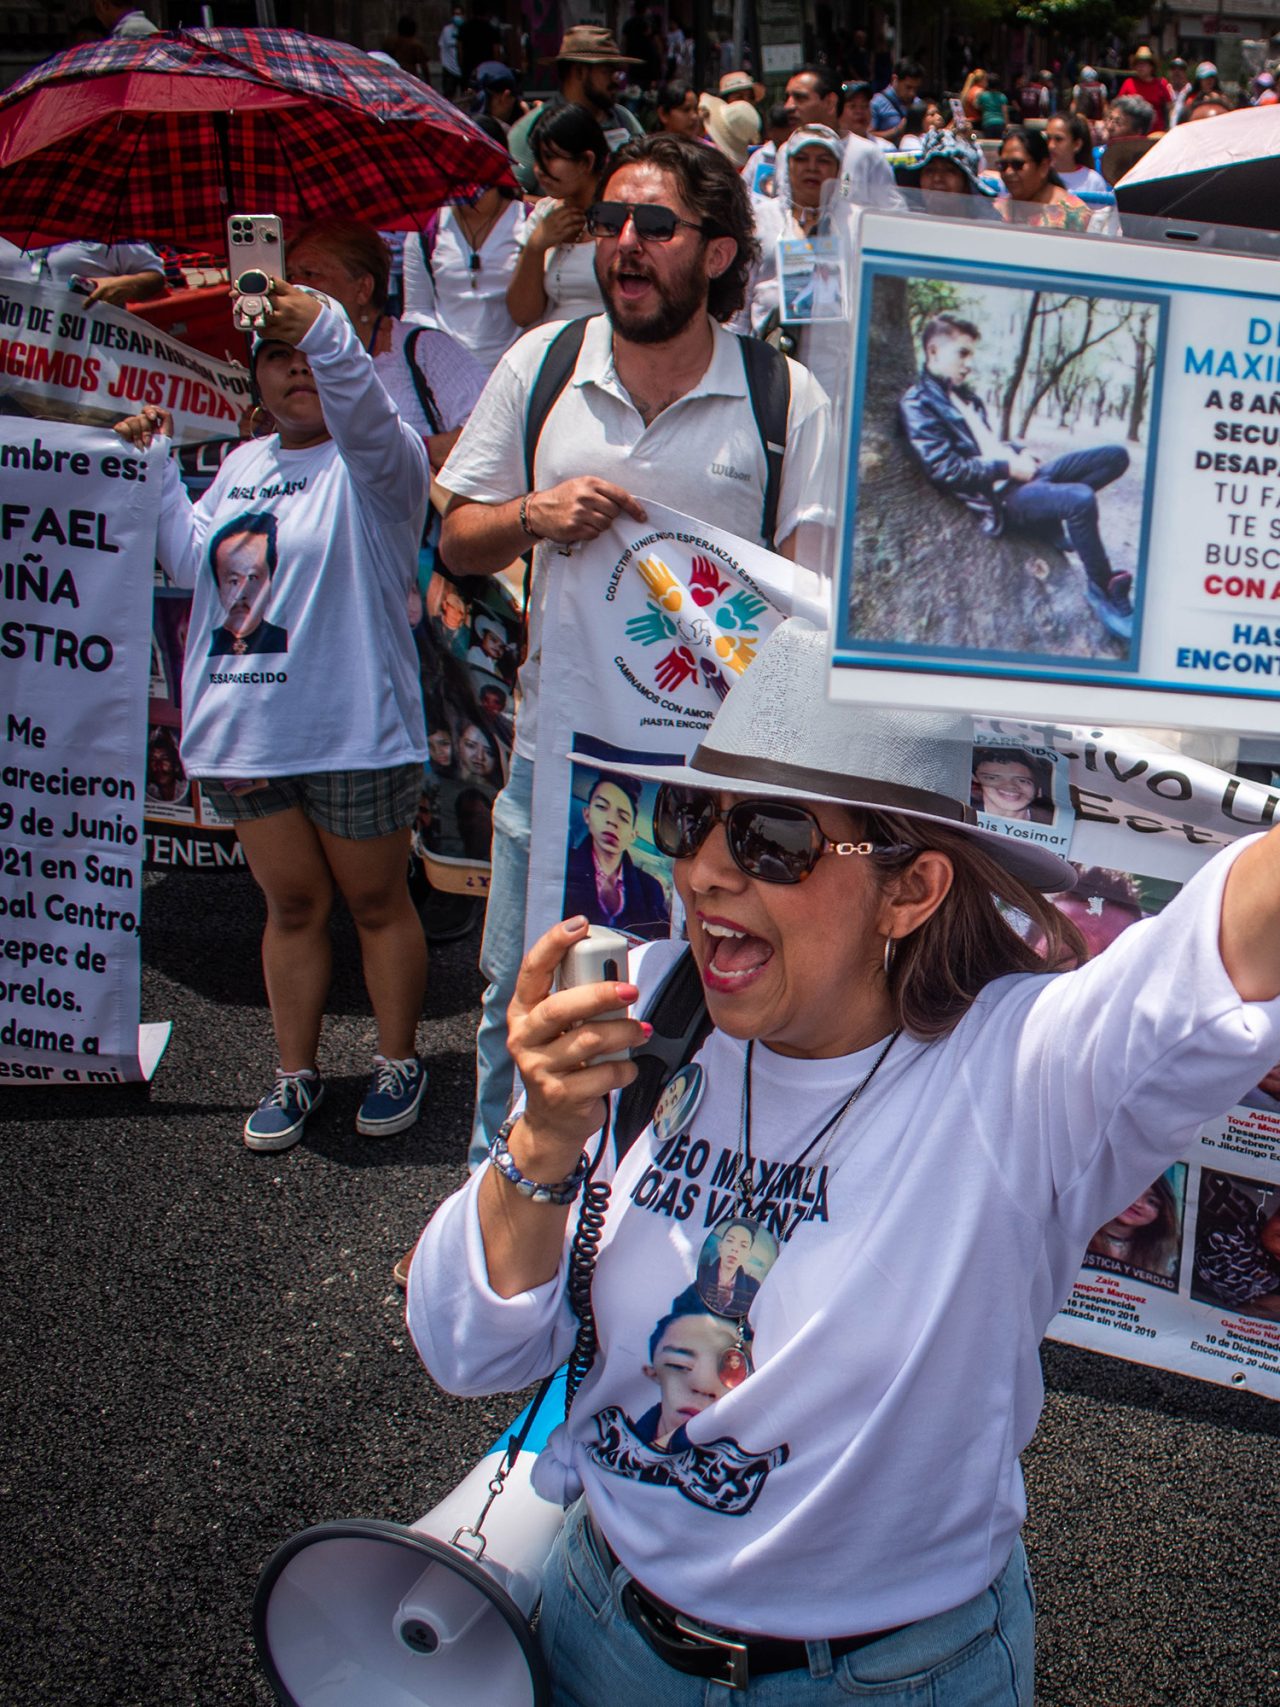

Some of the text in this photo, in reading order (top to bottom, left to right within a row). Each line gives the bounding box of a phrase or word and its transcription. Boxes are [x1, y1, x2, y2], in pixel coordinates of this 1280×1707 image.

[27, 305, 54, 334] DE
[58, 312, 87, 341] SU
[108, 364, 236, 421] JUSTICIA
[1205, 389, 1224, 410] A
[1228, 392, 1244, 412] 8
[101, 455, 147, 482] es:
[711, 463, 752, 482] Wilson
[1214, 483, 1249, 505] TU
[1, 503, 119, 553] FAEL
[1228, 514, 1257, 537] TE
[631, 531, 675, 552] UNIENDO
[676, 532, 739, 570] ESPERANZAS
[0, 553, 79, 608] IÑA
[1204, 575, 1265, 599] CON
[1, 621, 114, 673] STRO
[614, 656, 682, 714] CAMINAMOS CON
[7, 714, 46, 748] Me
[676, 717, 712, 731] ENCON
[0, 766, 135, 801] arecieron
[20, 807, 138, 845] de Junio
[1004, 824, 1068, 845] Yosimar
[40, 854, 133, 889] en San
[44, 894, 141, 938] Centro,
[75, 942, 107, 974] de
[0, 1018, 100, 1055] dame a
[62, 1067, 121, 1083] a mi
[1226, 1115, 1255, 1128] Tovar
[1201, 1136, 1267, 1158] En Jilotzingo
[1235, 1137, 1275, 1151] Febrero
[1095, 1275, 1120, 1287] Zaira
[1132, 1267, 1175, 1289] VERDAD
[1073, 1291, 1136, 1311] Desaparecida
[1107, 1288, 1147, 1304] Marquez
[1080, 1301, 1116, 1316] Febrero
[1097, 1316, 1157, 1338] sin vida 2019
[1238, 1317, 1278, 1331] Gonzalo
[1190, 1341, 1244, 1363] Encontrado
[1206, 1334, 1216, 1344] 10
[1218, 1338, 1230, 1348] de
[1232, 1341, 1278, 1362] Diciembre
